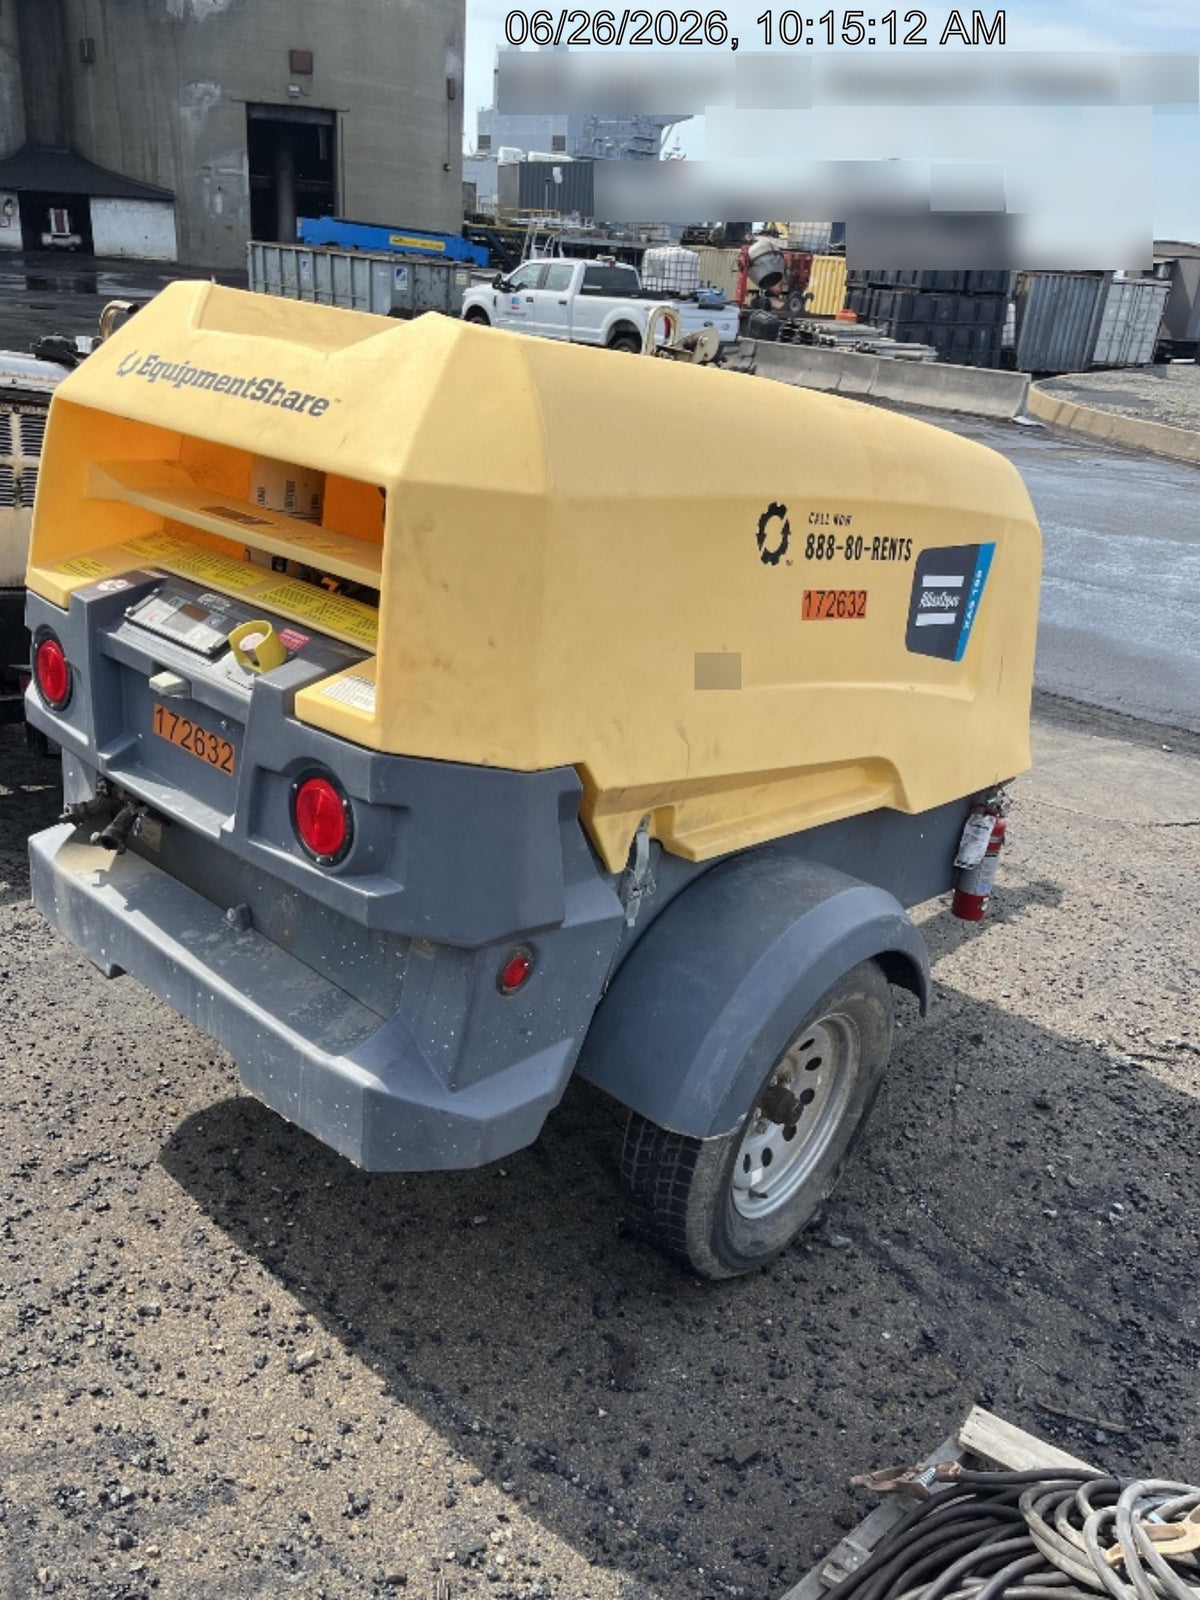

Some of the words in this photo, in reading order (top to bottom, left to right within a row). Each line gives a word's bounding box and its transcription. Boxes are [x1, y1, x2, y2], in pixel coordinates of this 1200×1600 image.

[137, 354, 330, 417] EquipmentShare
[808, 512, 830, 525] CALL
[805, 533, 913, 562] 888-80-RENTS
[804, 590, 867, 618] 172632
[155, 706, 234, 774] 172632
